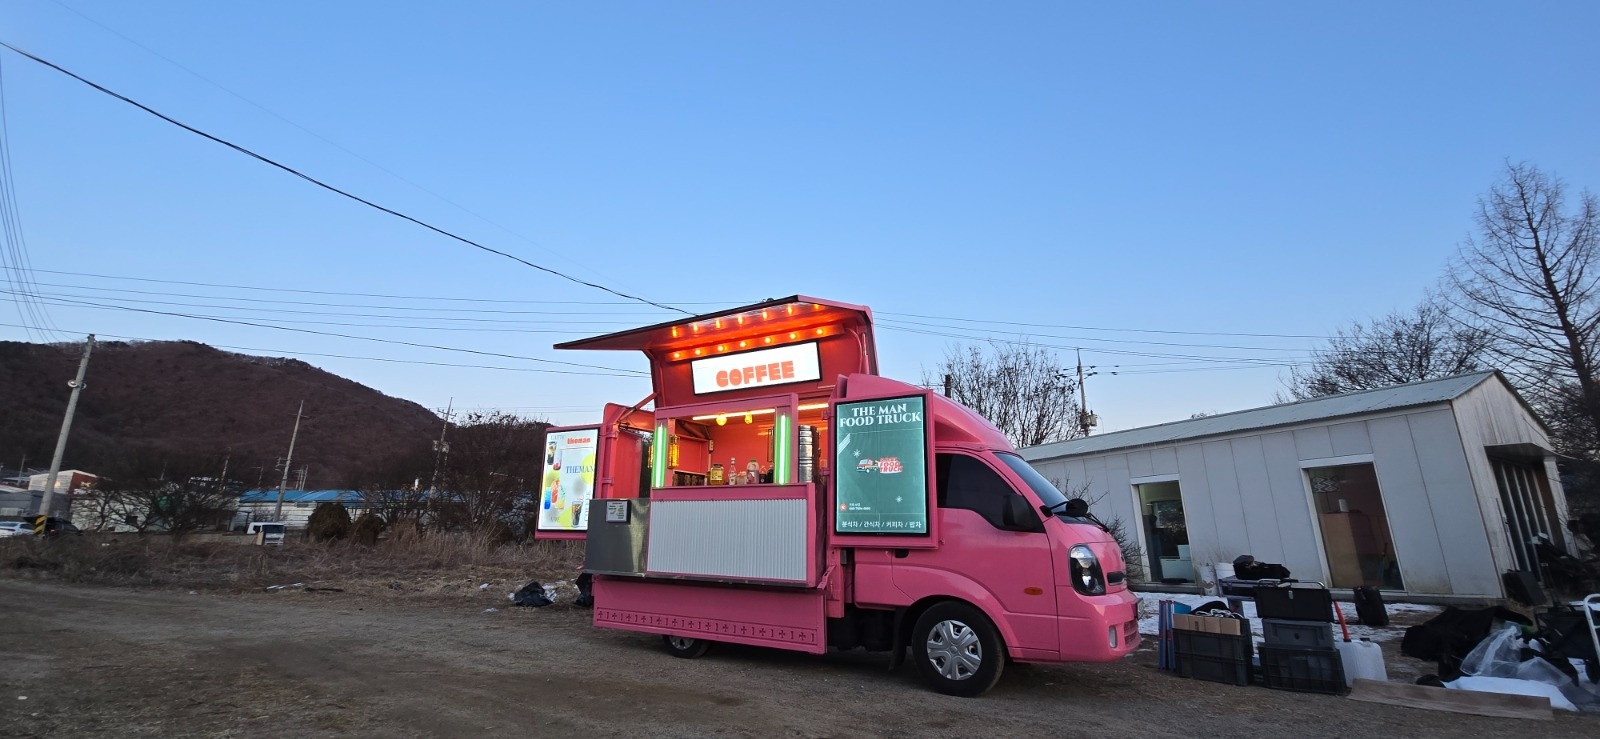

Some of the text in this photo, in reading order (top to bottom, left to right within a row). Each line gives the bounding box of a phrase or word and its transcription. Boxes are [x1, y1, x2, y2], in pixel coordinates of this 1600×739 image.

[716, 360, 795, 387] COFFEE
[852, 403, 907, 417] THE MAN
[840, 411, 922, 427] FOOD TRUCK
[842, 520, 858, 528] 분식차
[863, 520, 881, 528] 간식차
